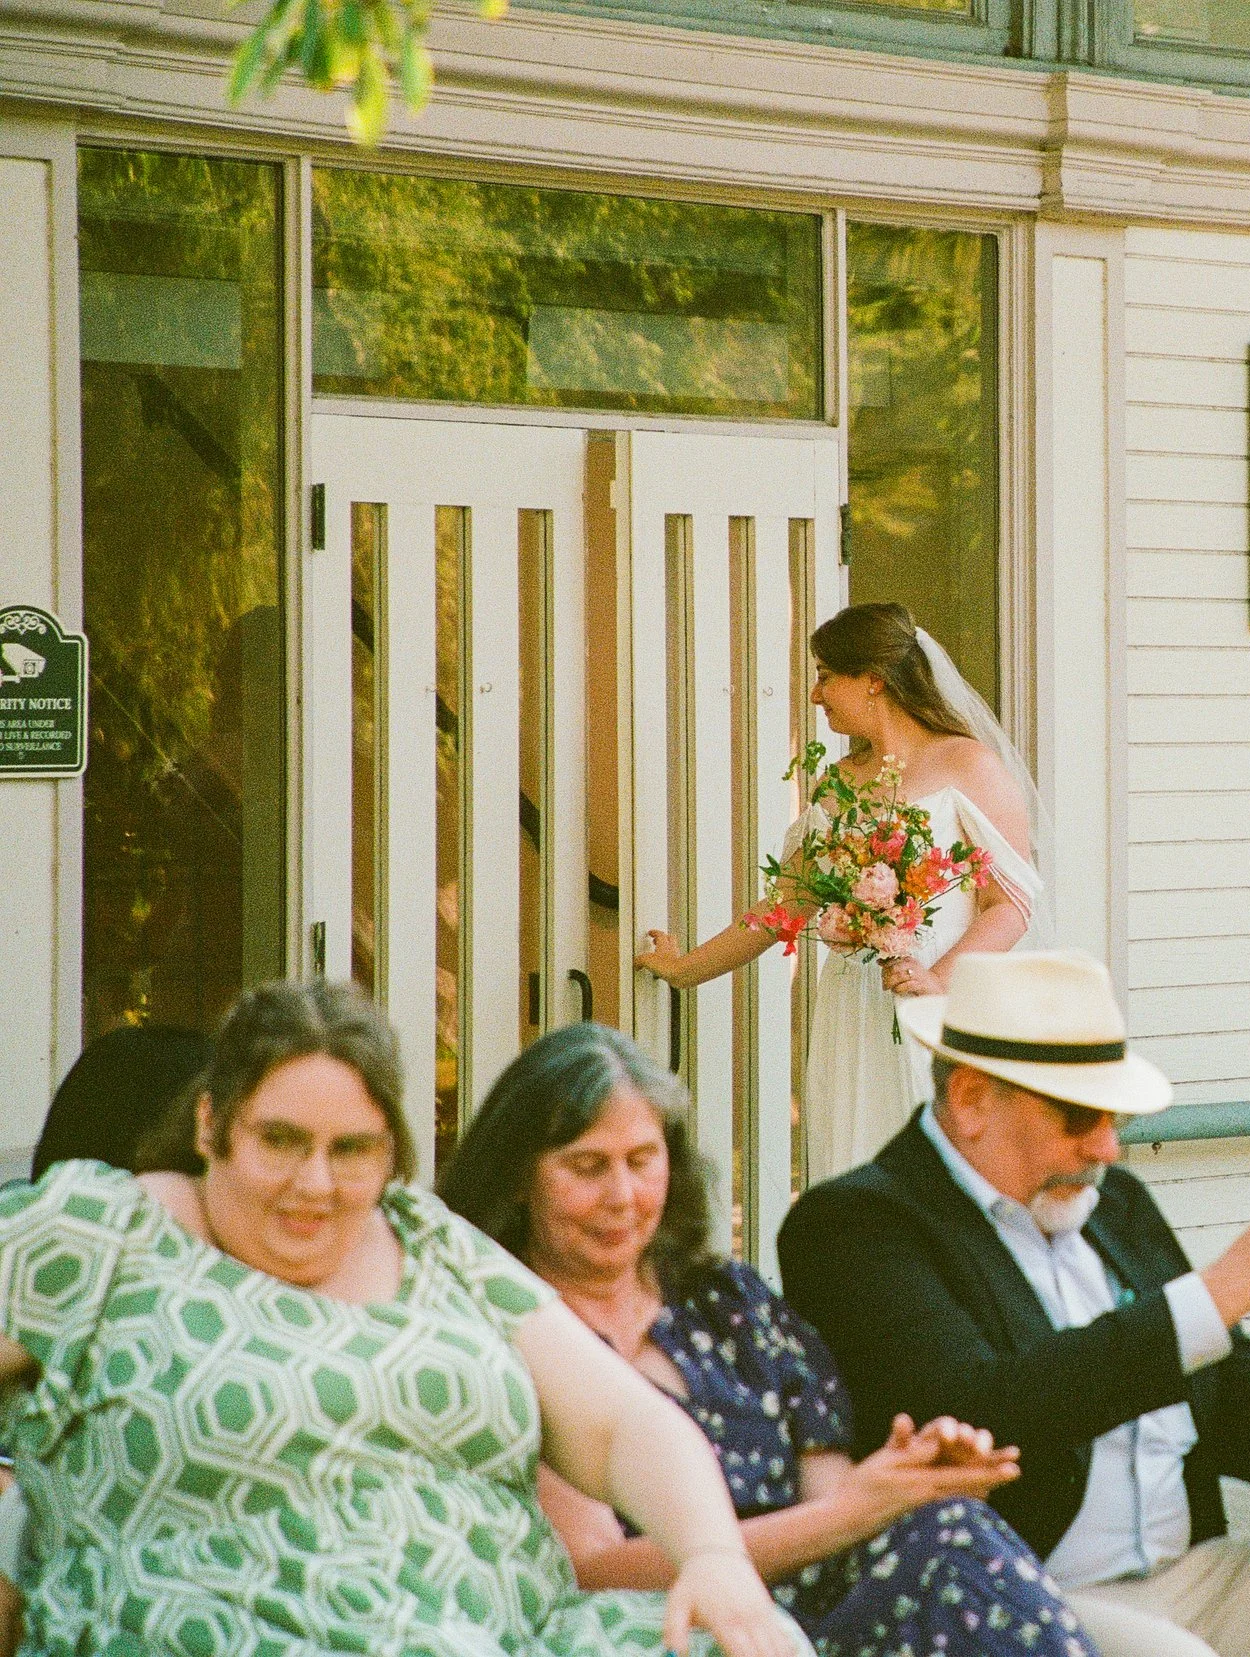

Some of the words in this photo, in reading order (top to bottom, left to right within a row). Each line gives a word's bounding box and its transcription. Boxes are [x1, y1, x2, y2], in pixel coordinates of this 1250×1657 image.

[29, 698, 72, 710] NOTICE
[7, 720, 27, 728] AREA
[28, 720, 55, 728] UNDER
[4, 731, 22, 739] LIVE
[30, 731, 72, 739] RECORDED
[5, 742, 62, 751] SURVEILLANCE
